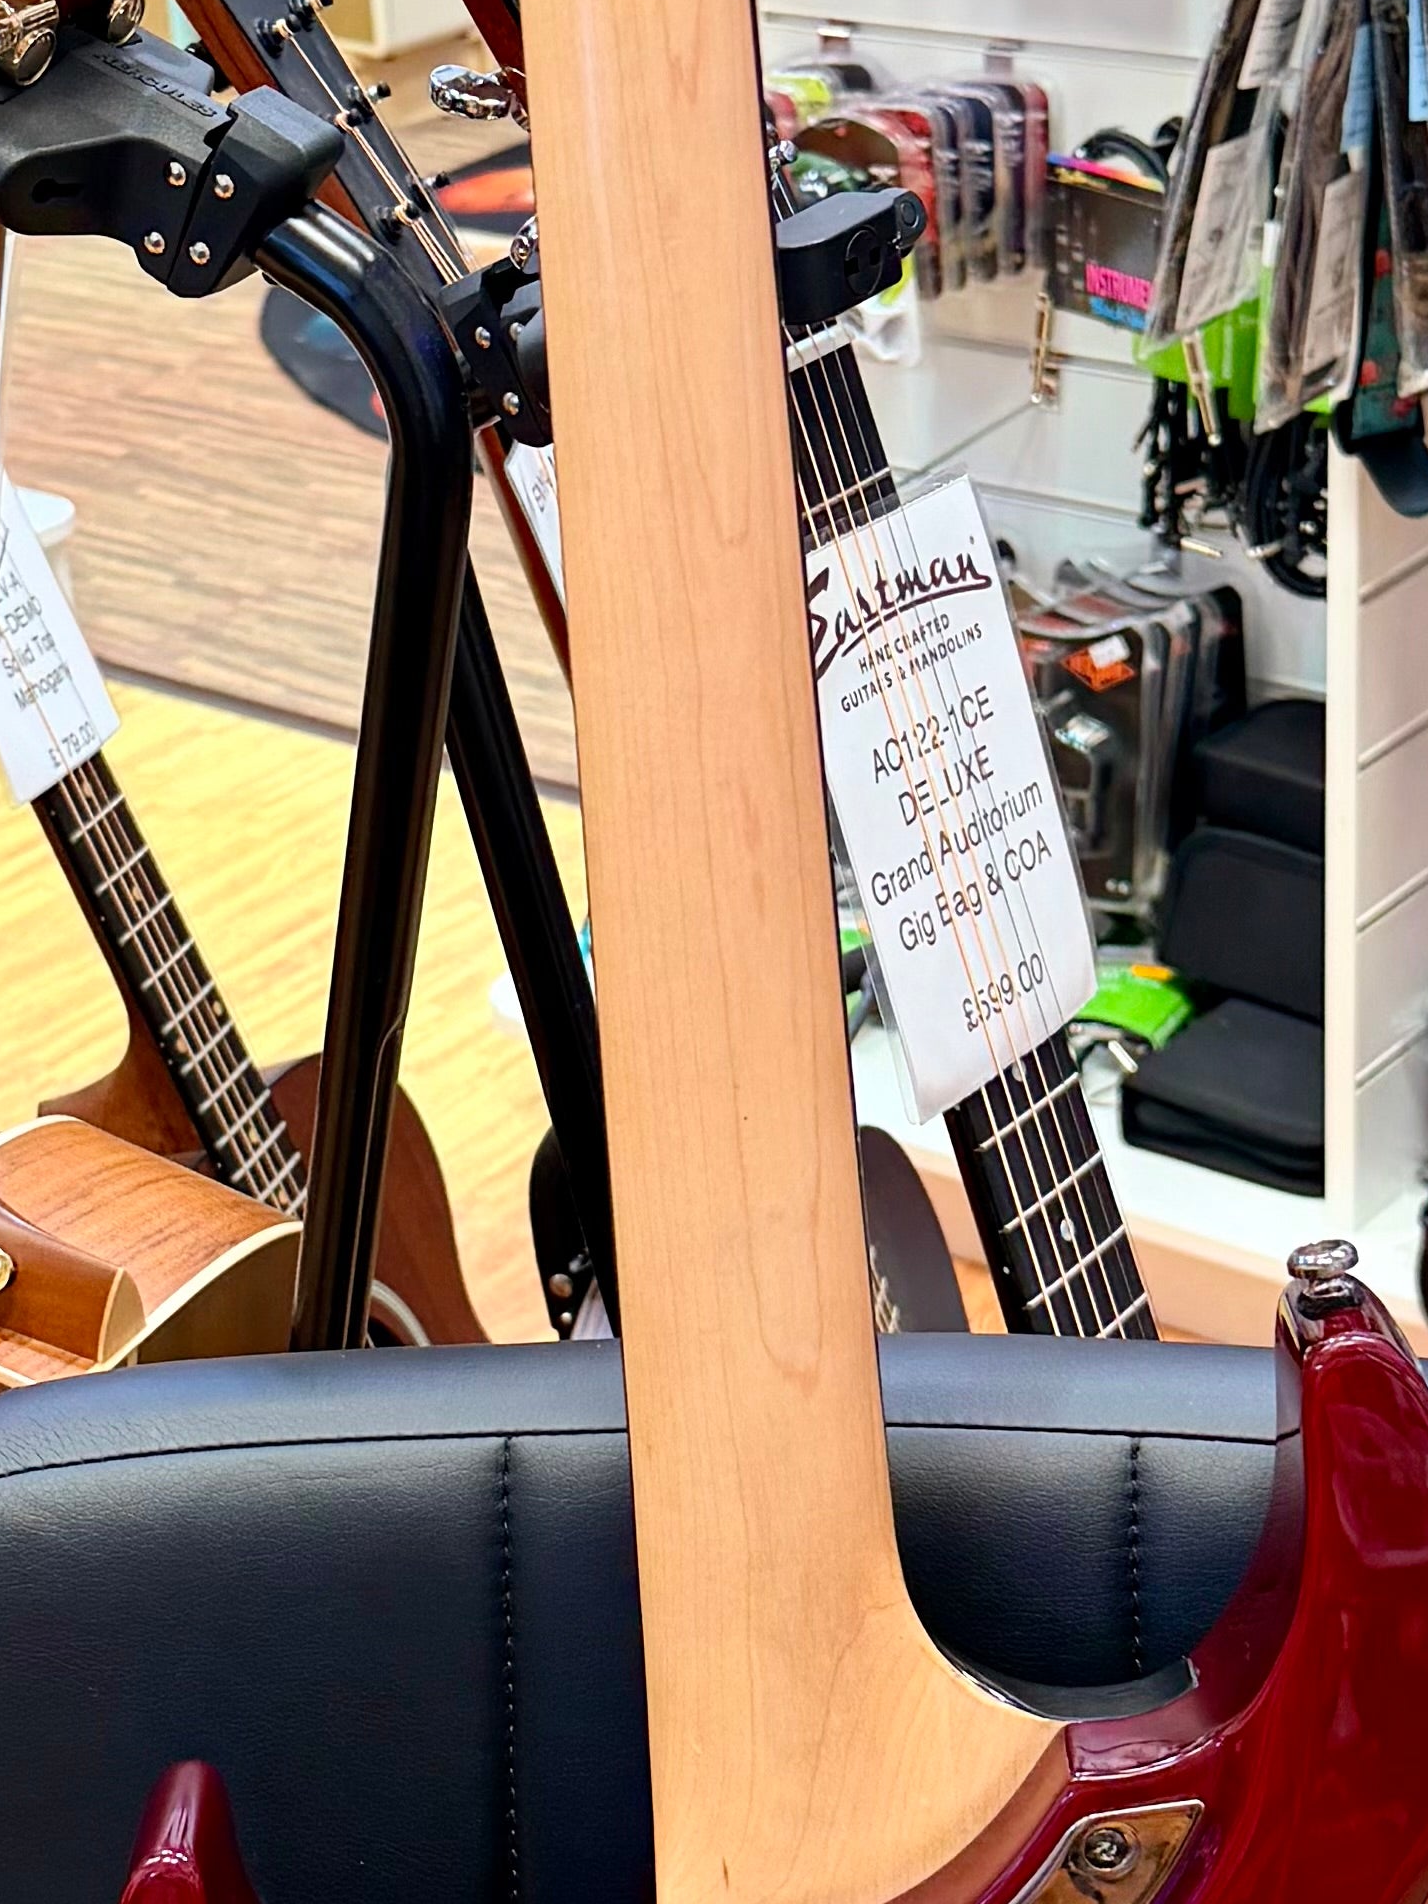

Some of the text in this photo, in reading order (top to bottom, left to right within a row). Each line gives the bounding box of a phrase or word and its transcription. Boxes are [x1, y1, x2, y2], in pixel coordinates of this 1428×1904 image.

[908, 622, 983, 680] MANDOLINS
[870, 780, 1044, 909] Grand Auditorium
[899, 902, 936, 953] Gig
[985, 860, 1004, 894] &
[1003, 829, 1053, 879] COA
